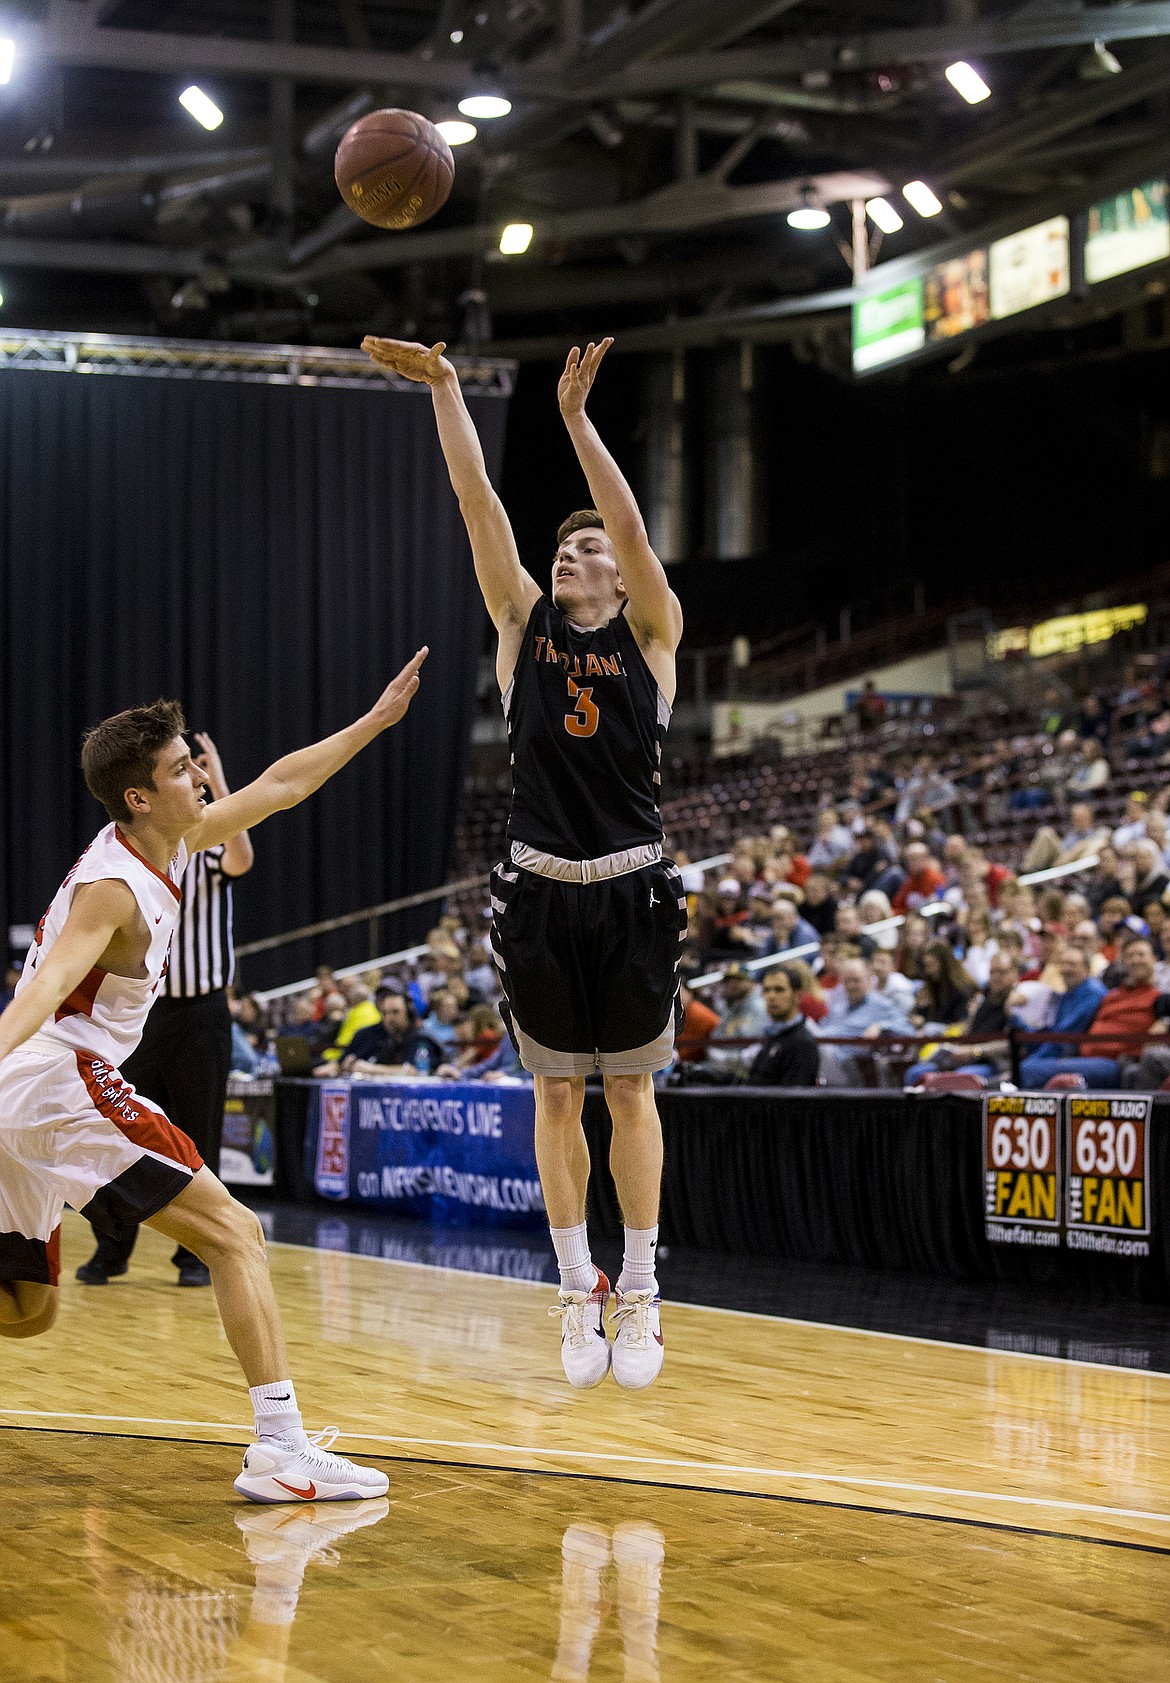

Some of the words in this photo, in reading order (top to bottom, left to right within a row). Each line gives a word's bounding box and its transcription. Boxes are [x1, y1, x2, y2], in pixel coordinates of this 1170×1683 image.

[534, 635, 628, 677] TROJAN
[563, 676, 600, 738] 3
[466, 1101, 503, 1138] LIVE
[1025, 1099, 1056, 1116] RADIO
[1111, 1101, 1147, 1119] RADIO
[991, 1116, 1051, 1170] 630
[1076, 1119, 1138, 1176] 630
[357, 1171, 380, 1198] on
[985, 1171, 997, 1215] THE
[995, 1171, 1056, 1220] FAN
[1069, 1176, 1083, 1221] THE
[1082, 1177, 1143, 1228] FAN
